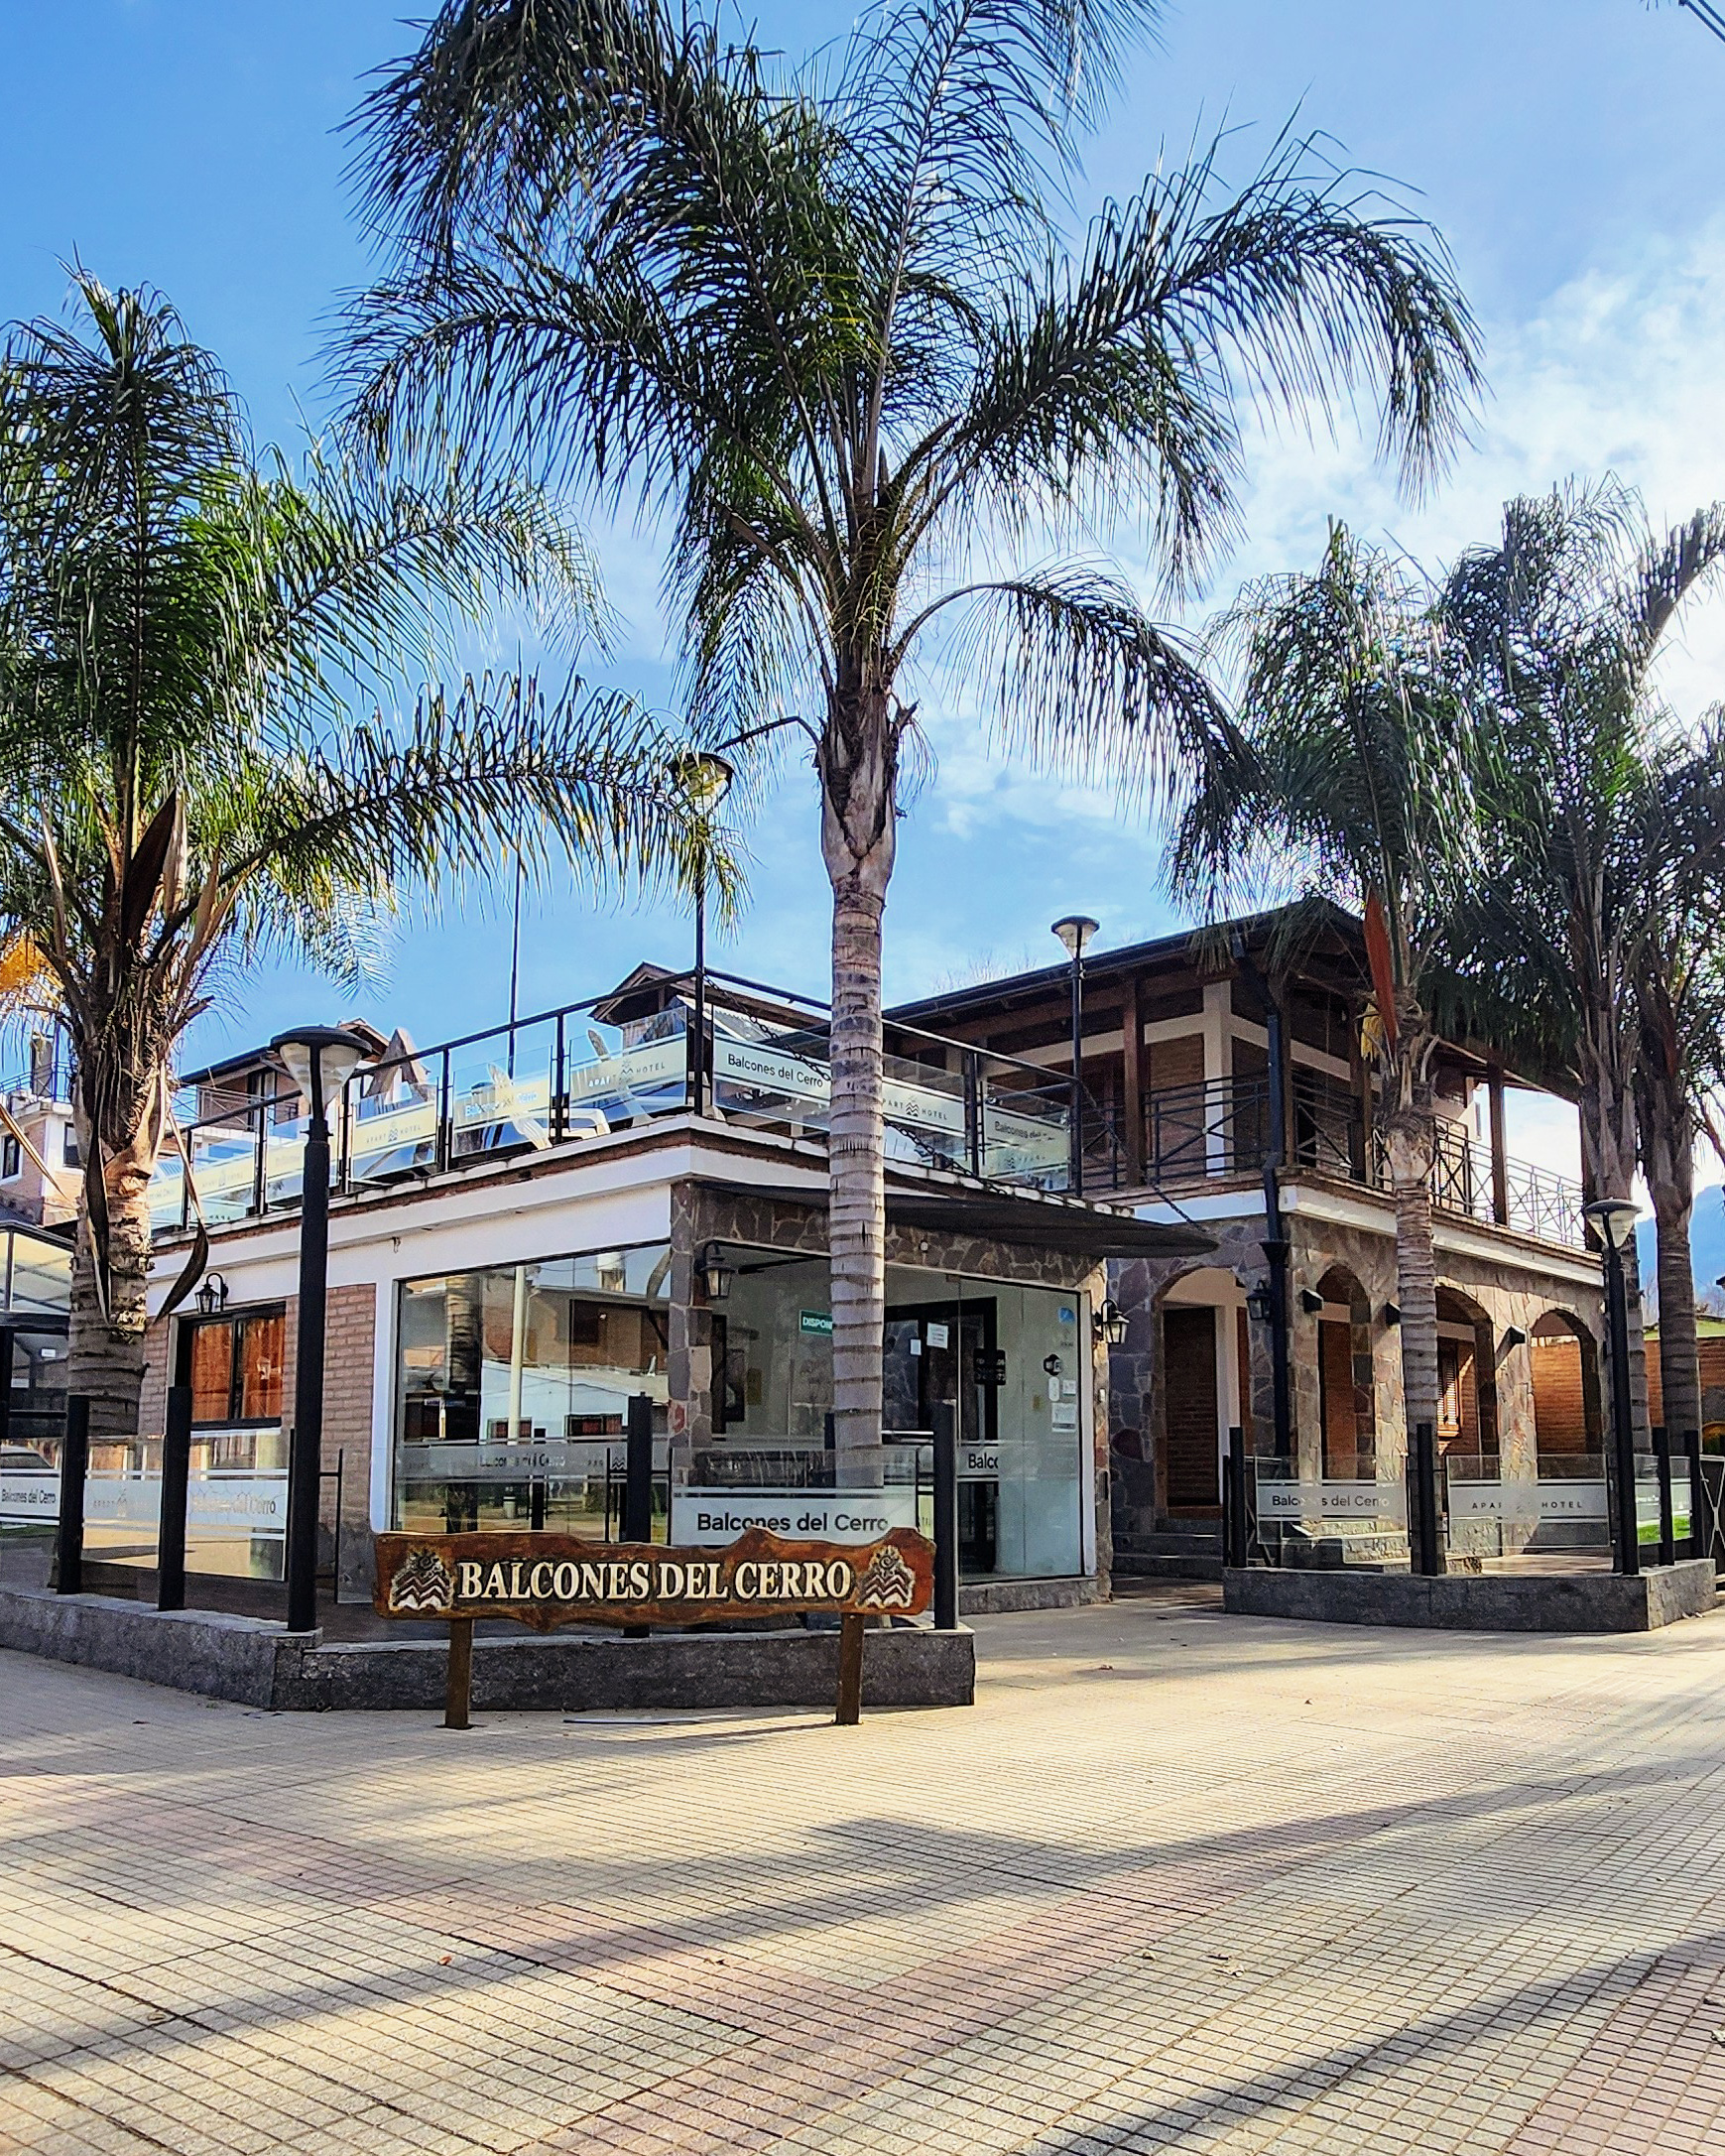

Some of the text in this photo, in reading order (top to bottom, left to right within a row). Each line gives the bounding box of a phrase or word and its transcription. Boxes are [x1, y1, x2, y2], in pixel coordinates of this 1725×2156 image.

[636, 1062, 666, 1074] HOTEL
[727, 1053, 823, 1087] Balcones del Cerro
[882, 1097, 947, 1120] PART HOTEL
[400, 1123, 422, 1135] HOTEL
[1330, 1494, 1350, 1507] del
[697, 1511, 890, 1532] Balcones del Cerro
[457, 1561, 852, 1600] BALCONES DEL CERRO
